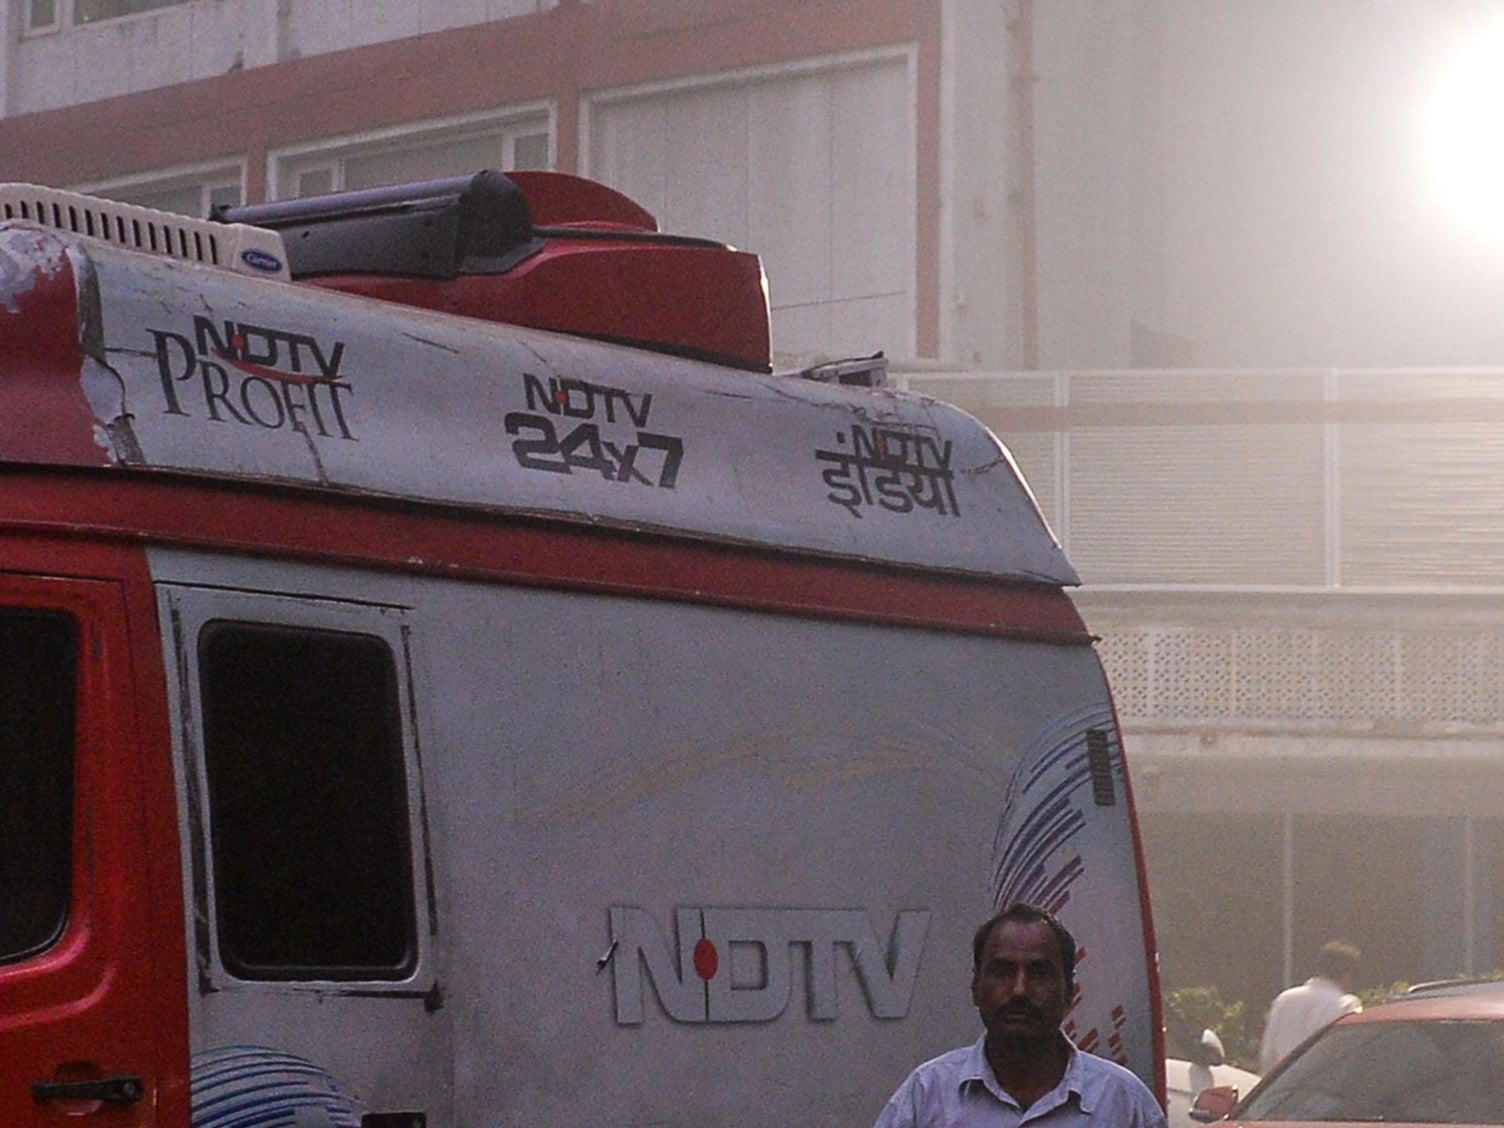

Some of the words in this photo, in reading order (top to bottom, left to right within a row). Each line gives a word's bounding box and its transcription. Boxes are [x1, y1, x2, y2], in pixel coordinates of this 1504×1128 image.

[193, 314, 345, 378] NDTV
[145, 328, 360, 442] PROFIT
[523, 373, 653, 428] NDTV
[851, 424, 953, 472] NDTV
[608, 905, 933, 1026] NDTV
